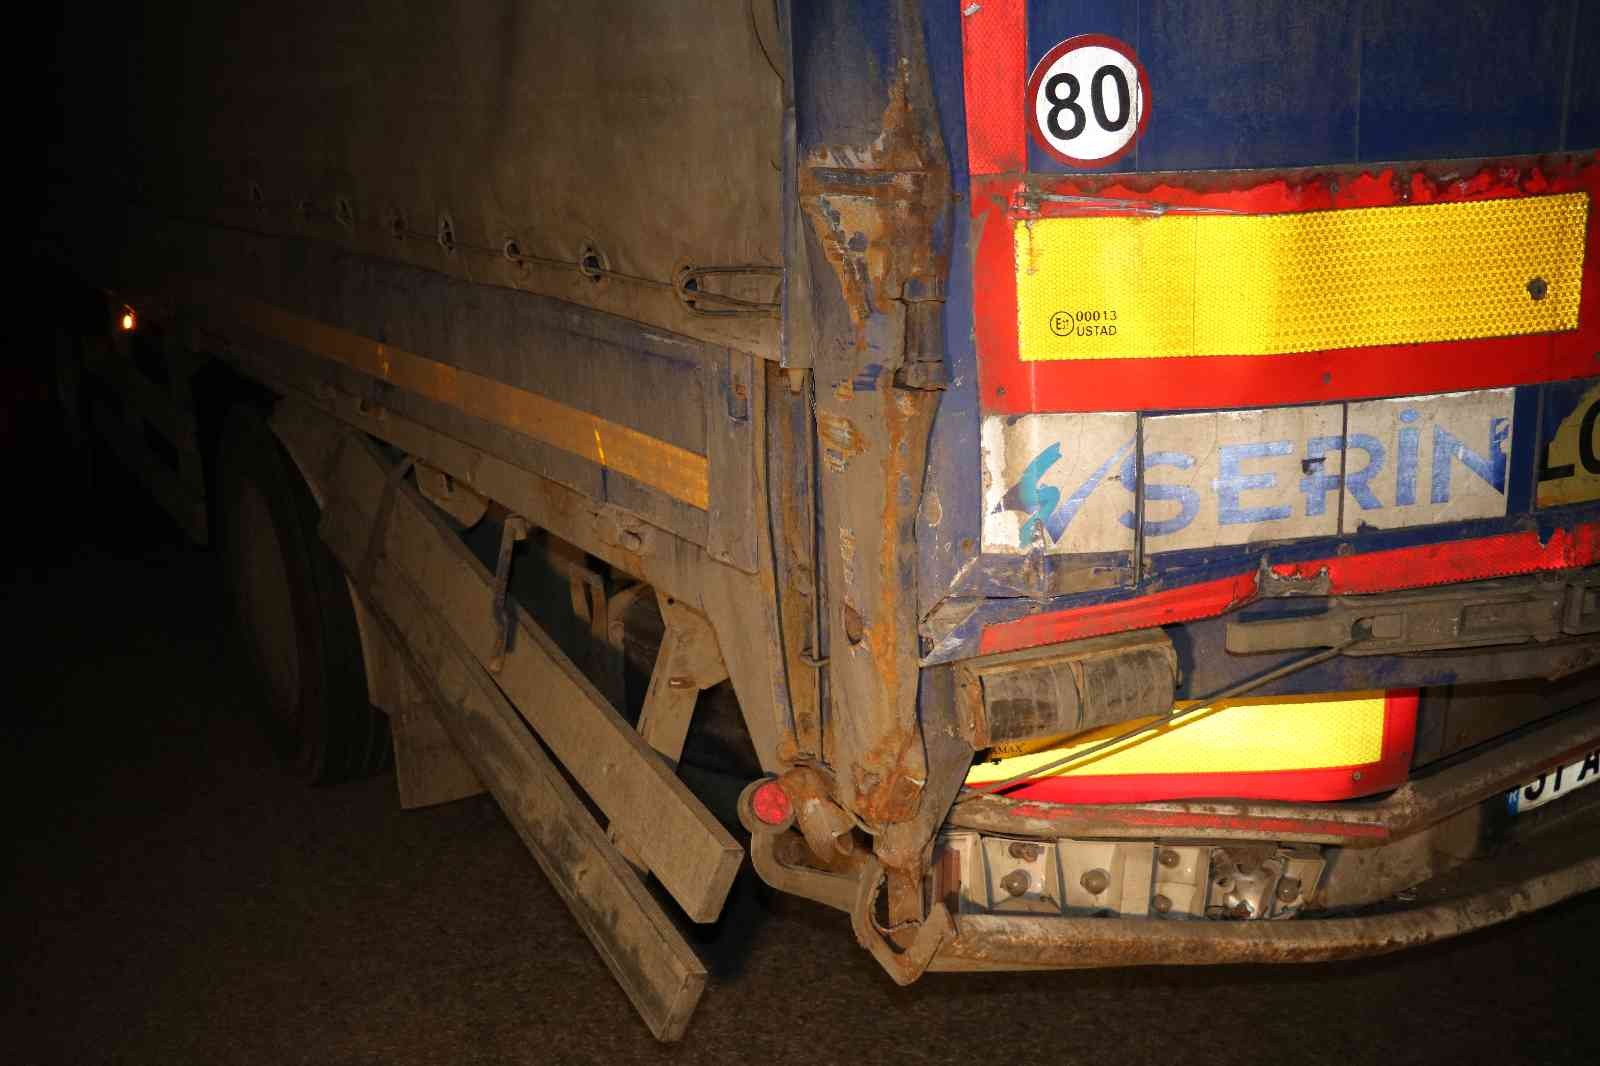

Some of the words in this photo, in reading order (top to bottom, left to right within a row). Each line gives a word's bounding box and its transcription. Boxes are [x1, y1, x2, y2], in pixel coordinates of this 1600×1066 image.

[1045, 64, 1132, 140] 80
[1076, 310, 1117, 321] 00013
[1076, 325, 1117, 336] USTAD
